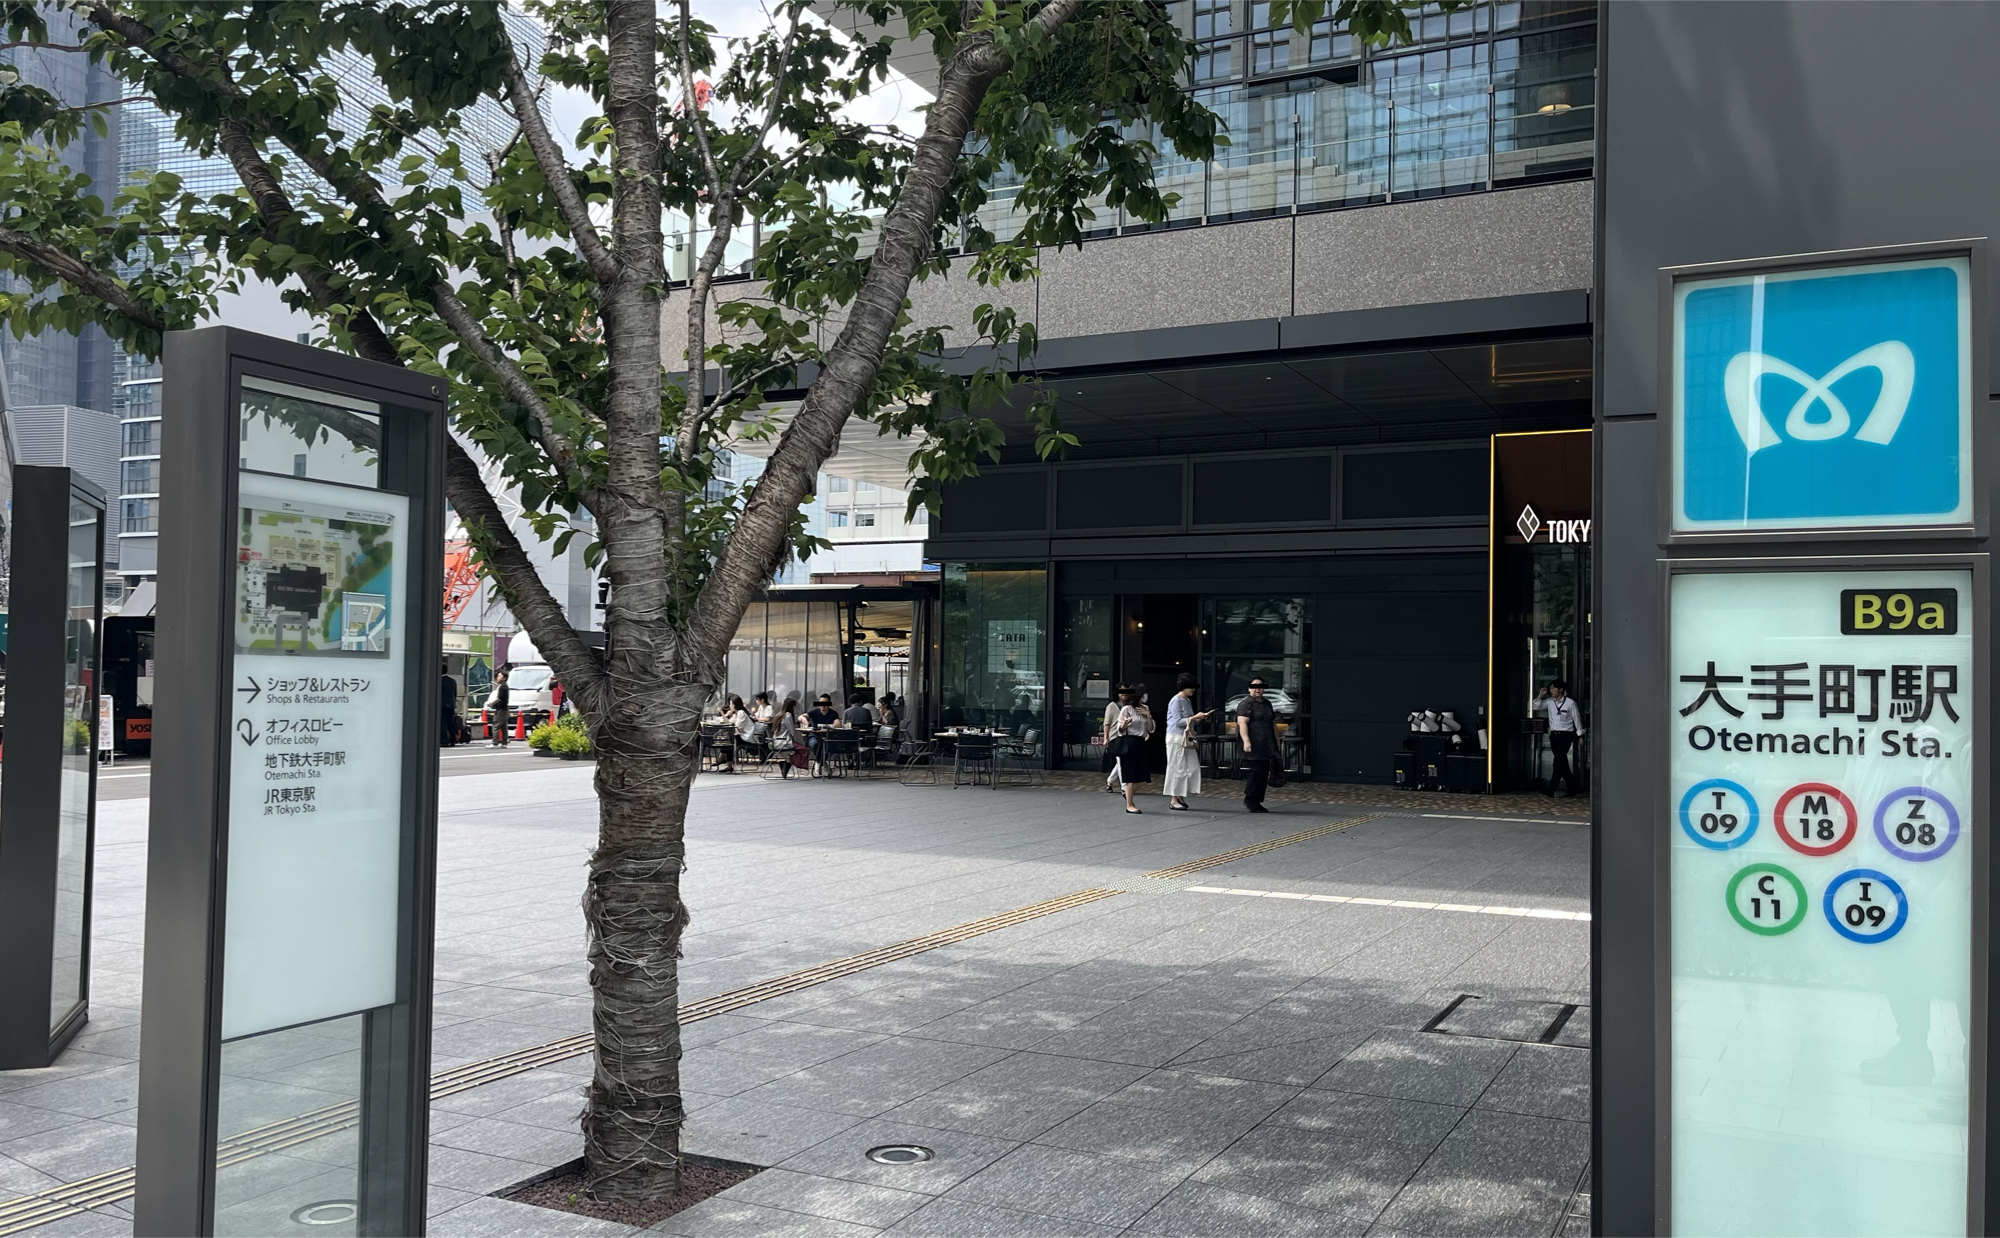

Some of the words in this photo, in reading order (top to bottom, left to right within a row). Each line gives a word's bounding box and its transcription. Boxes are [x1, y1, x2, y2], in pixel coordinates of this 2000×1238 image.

[1546, 519, 1591, 543] TOKY
[1853, 593, 1946, 631] B9a
[267, 677, 371, 692] ショップ&レストラン
[1678, 660, 1960, 724] 大手町駅
[266, 694, 292, 705] Shops
[294, 694, 301, 704] &
[302, 694, 350, 704] Restaurants
[266, 718, 344, 734] オフィスロビー
[266, 735, 292, 746] Office
[294, 735, 320, 746] Lobby
[1687, 724, 1866, 756] Otemachi
[1880, 729, 1953, 759] Sta.
[264, 751, 346, 769] 地下鉄大手町駅
[264, 769, 306, 781] Otemachi
[308, 769, 323, 779] Sta.
[264, 786, 316, 804] JR東京駅
[1711, 791, 1727, 810] T
[1802, 795, 1829, 815] M
[263, 806, 274, 816] JR
[276, 804, 301, 816] Tokyo
[302, 804, 318, 813] Sta.
[1906, 800, 1926, 820] Z
[1699, 813, 1738, 834] 09
[1799, 817, 1835, 841] 18
[1895, 822, 1937, 846] 08
[1757, 875, 1775, 896] C
[1858, 883, 1873, 902] I
[1750, 898, 1782, 920] 11
[1844, 905, 1887, 928] 09
